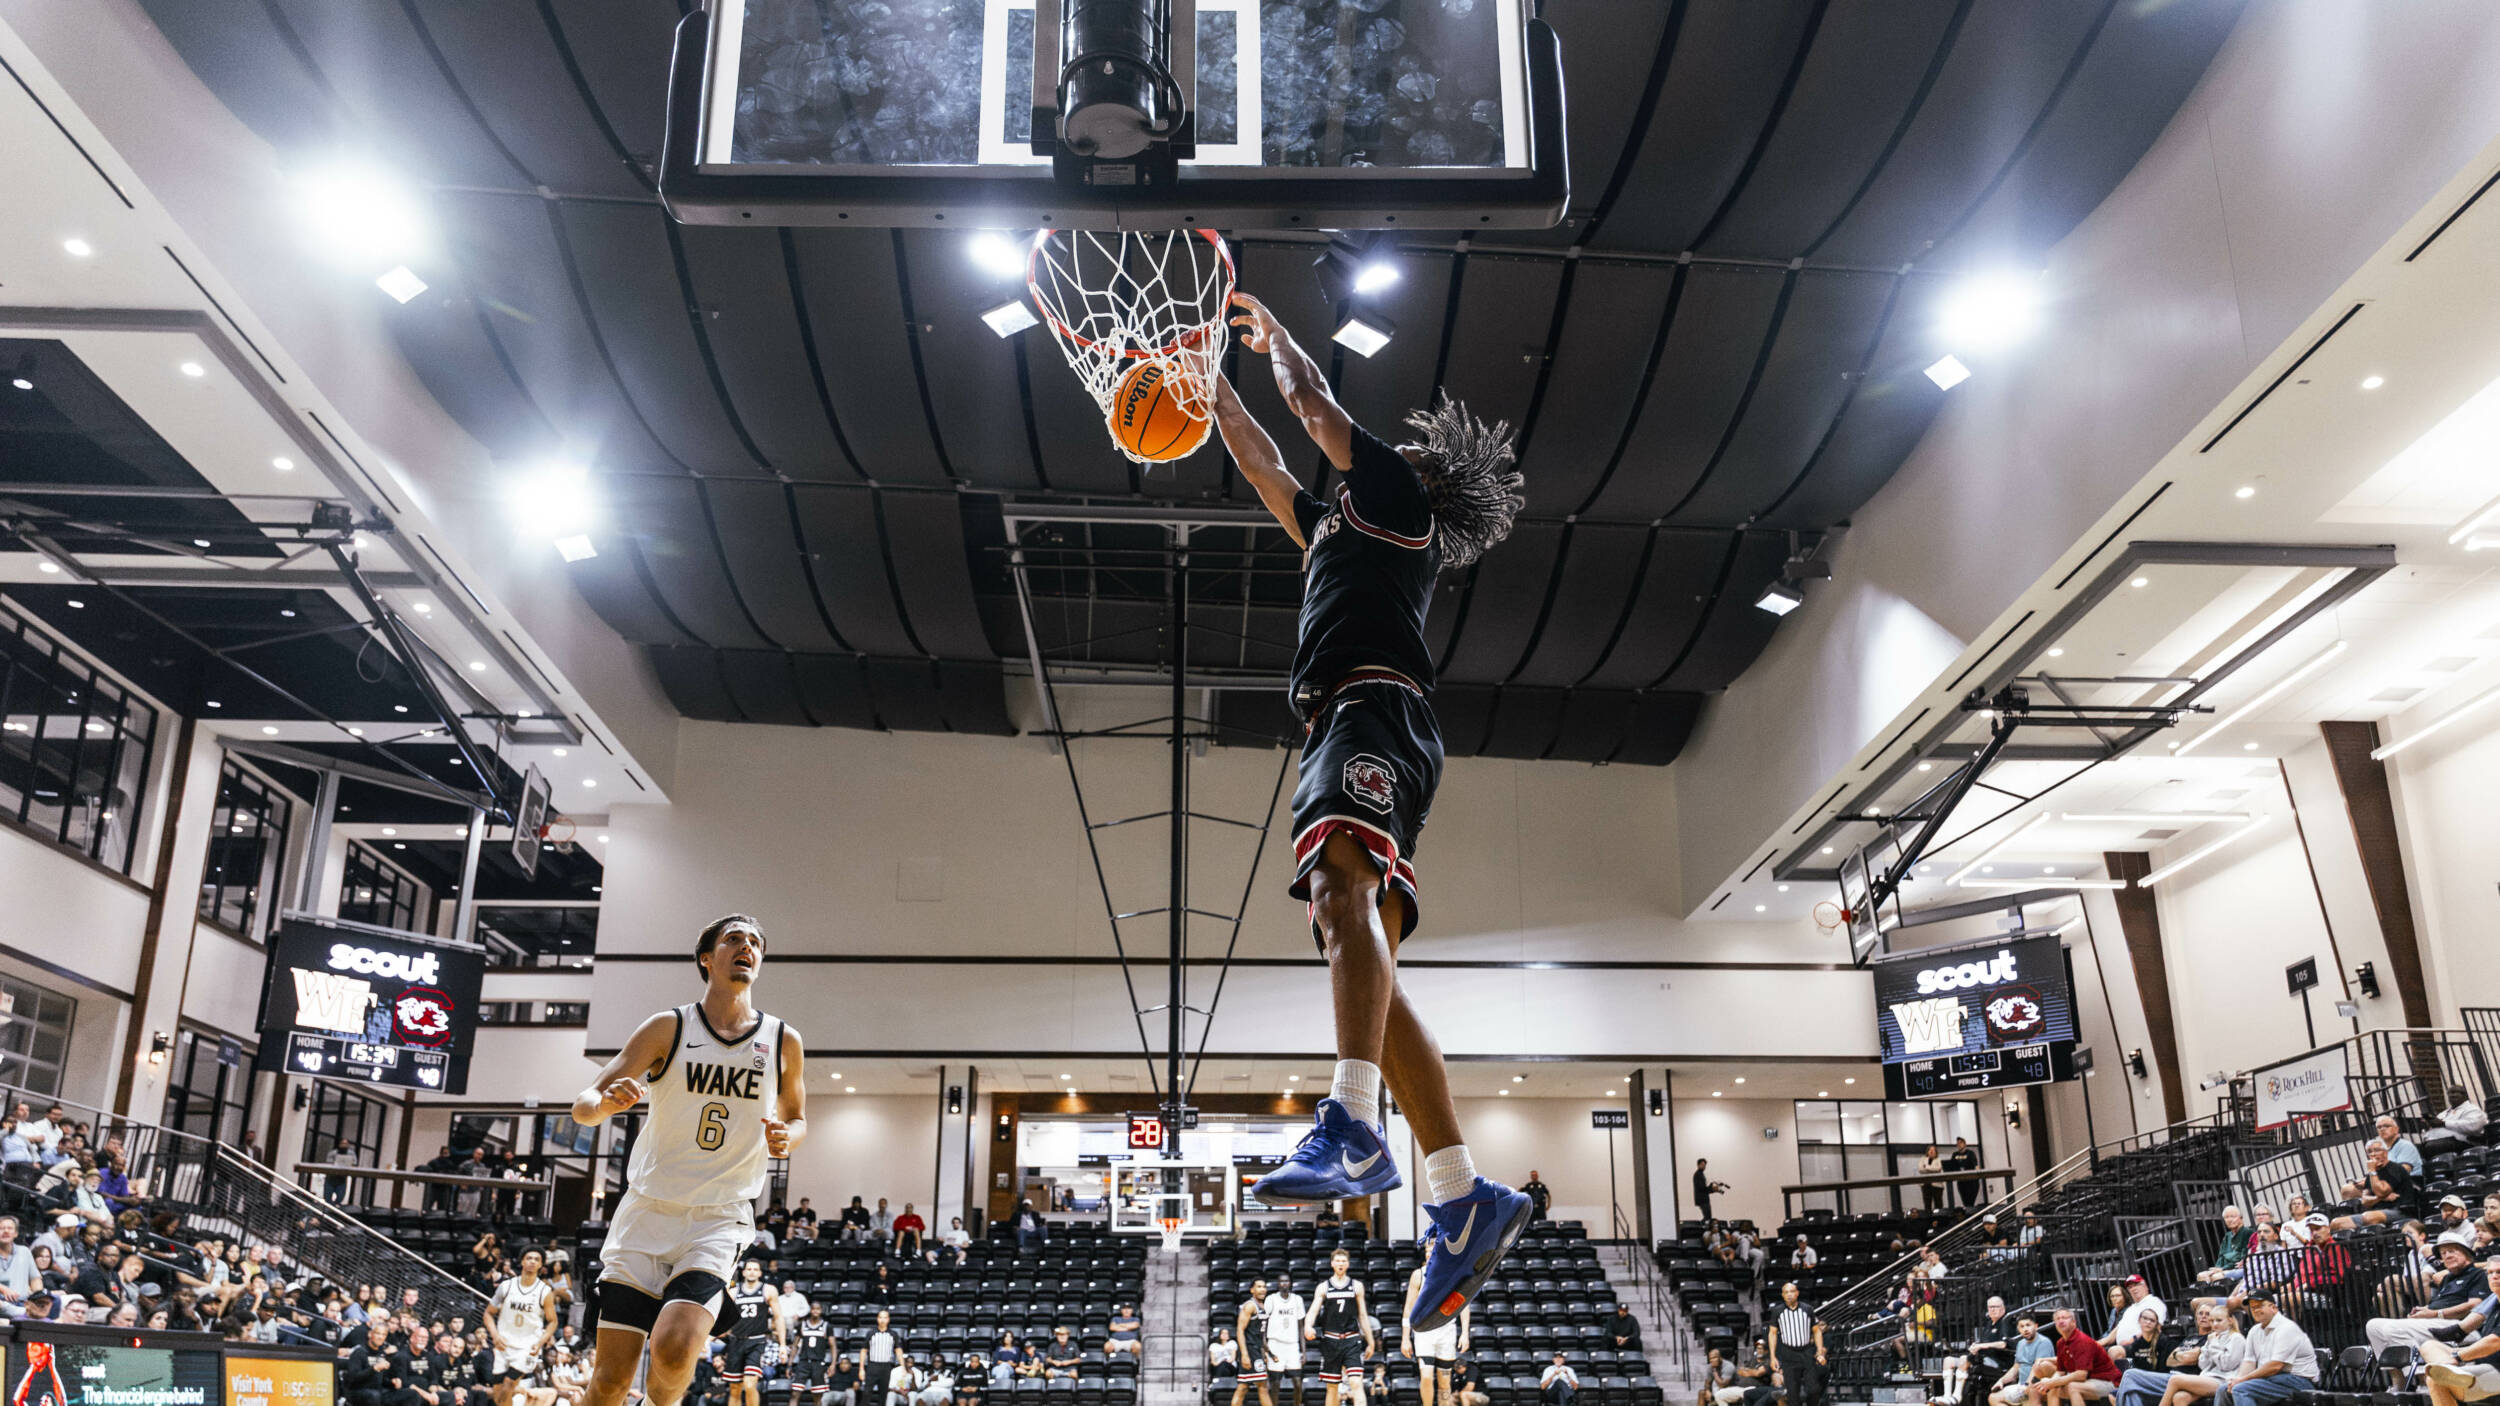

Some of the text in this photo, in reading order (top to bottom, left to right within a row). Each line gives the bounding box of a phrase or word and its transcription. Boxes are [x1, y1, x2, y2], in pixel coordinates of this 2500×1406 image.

[1123, 366, 1164, 427] Wilson
[327, 943, 440, 986] scout
[1917, 950, 2018, 994] scout
[2294, 969, 2308, 984] 105
[296, 1035, 325, 1050] HOME
[350, 1043, 396, 1065] 15:39
[413, 1052, 443, 1066] GUEST
[2015, 1045, 2044, 1060] GUEST
[1909, 1060, 1934, 1073] HOME
[1957, 1053, 1997, 1071] 15:39
[2023, 1062, 2044, 1078] 48
[371, 1066, 382, 1082] 2
[686, 1061, 764, 1101] WAKE
[1958, 1073, 1990, 1087] PERIOD 2
[696, 1101, 730, 1152] 6
[1594, 1114, 1626, 1124] 103-104
[1130, 1120, 1160, 1146] 28
[510, 1301, 534, 1313] WAKE
[741, 1304, 757, 1318] 23
[1336, 1299, 1346, 1313] 7
[514, 1314, 524, 1328] 0
[231, 1374, 273, 1394] Visit York
[82, 1385, 205, 1406] The financial engine behind
